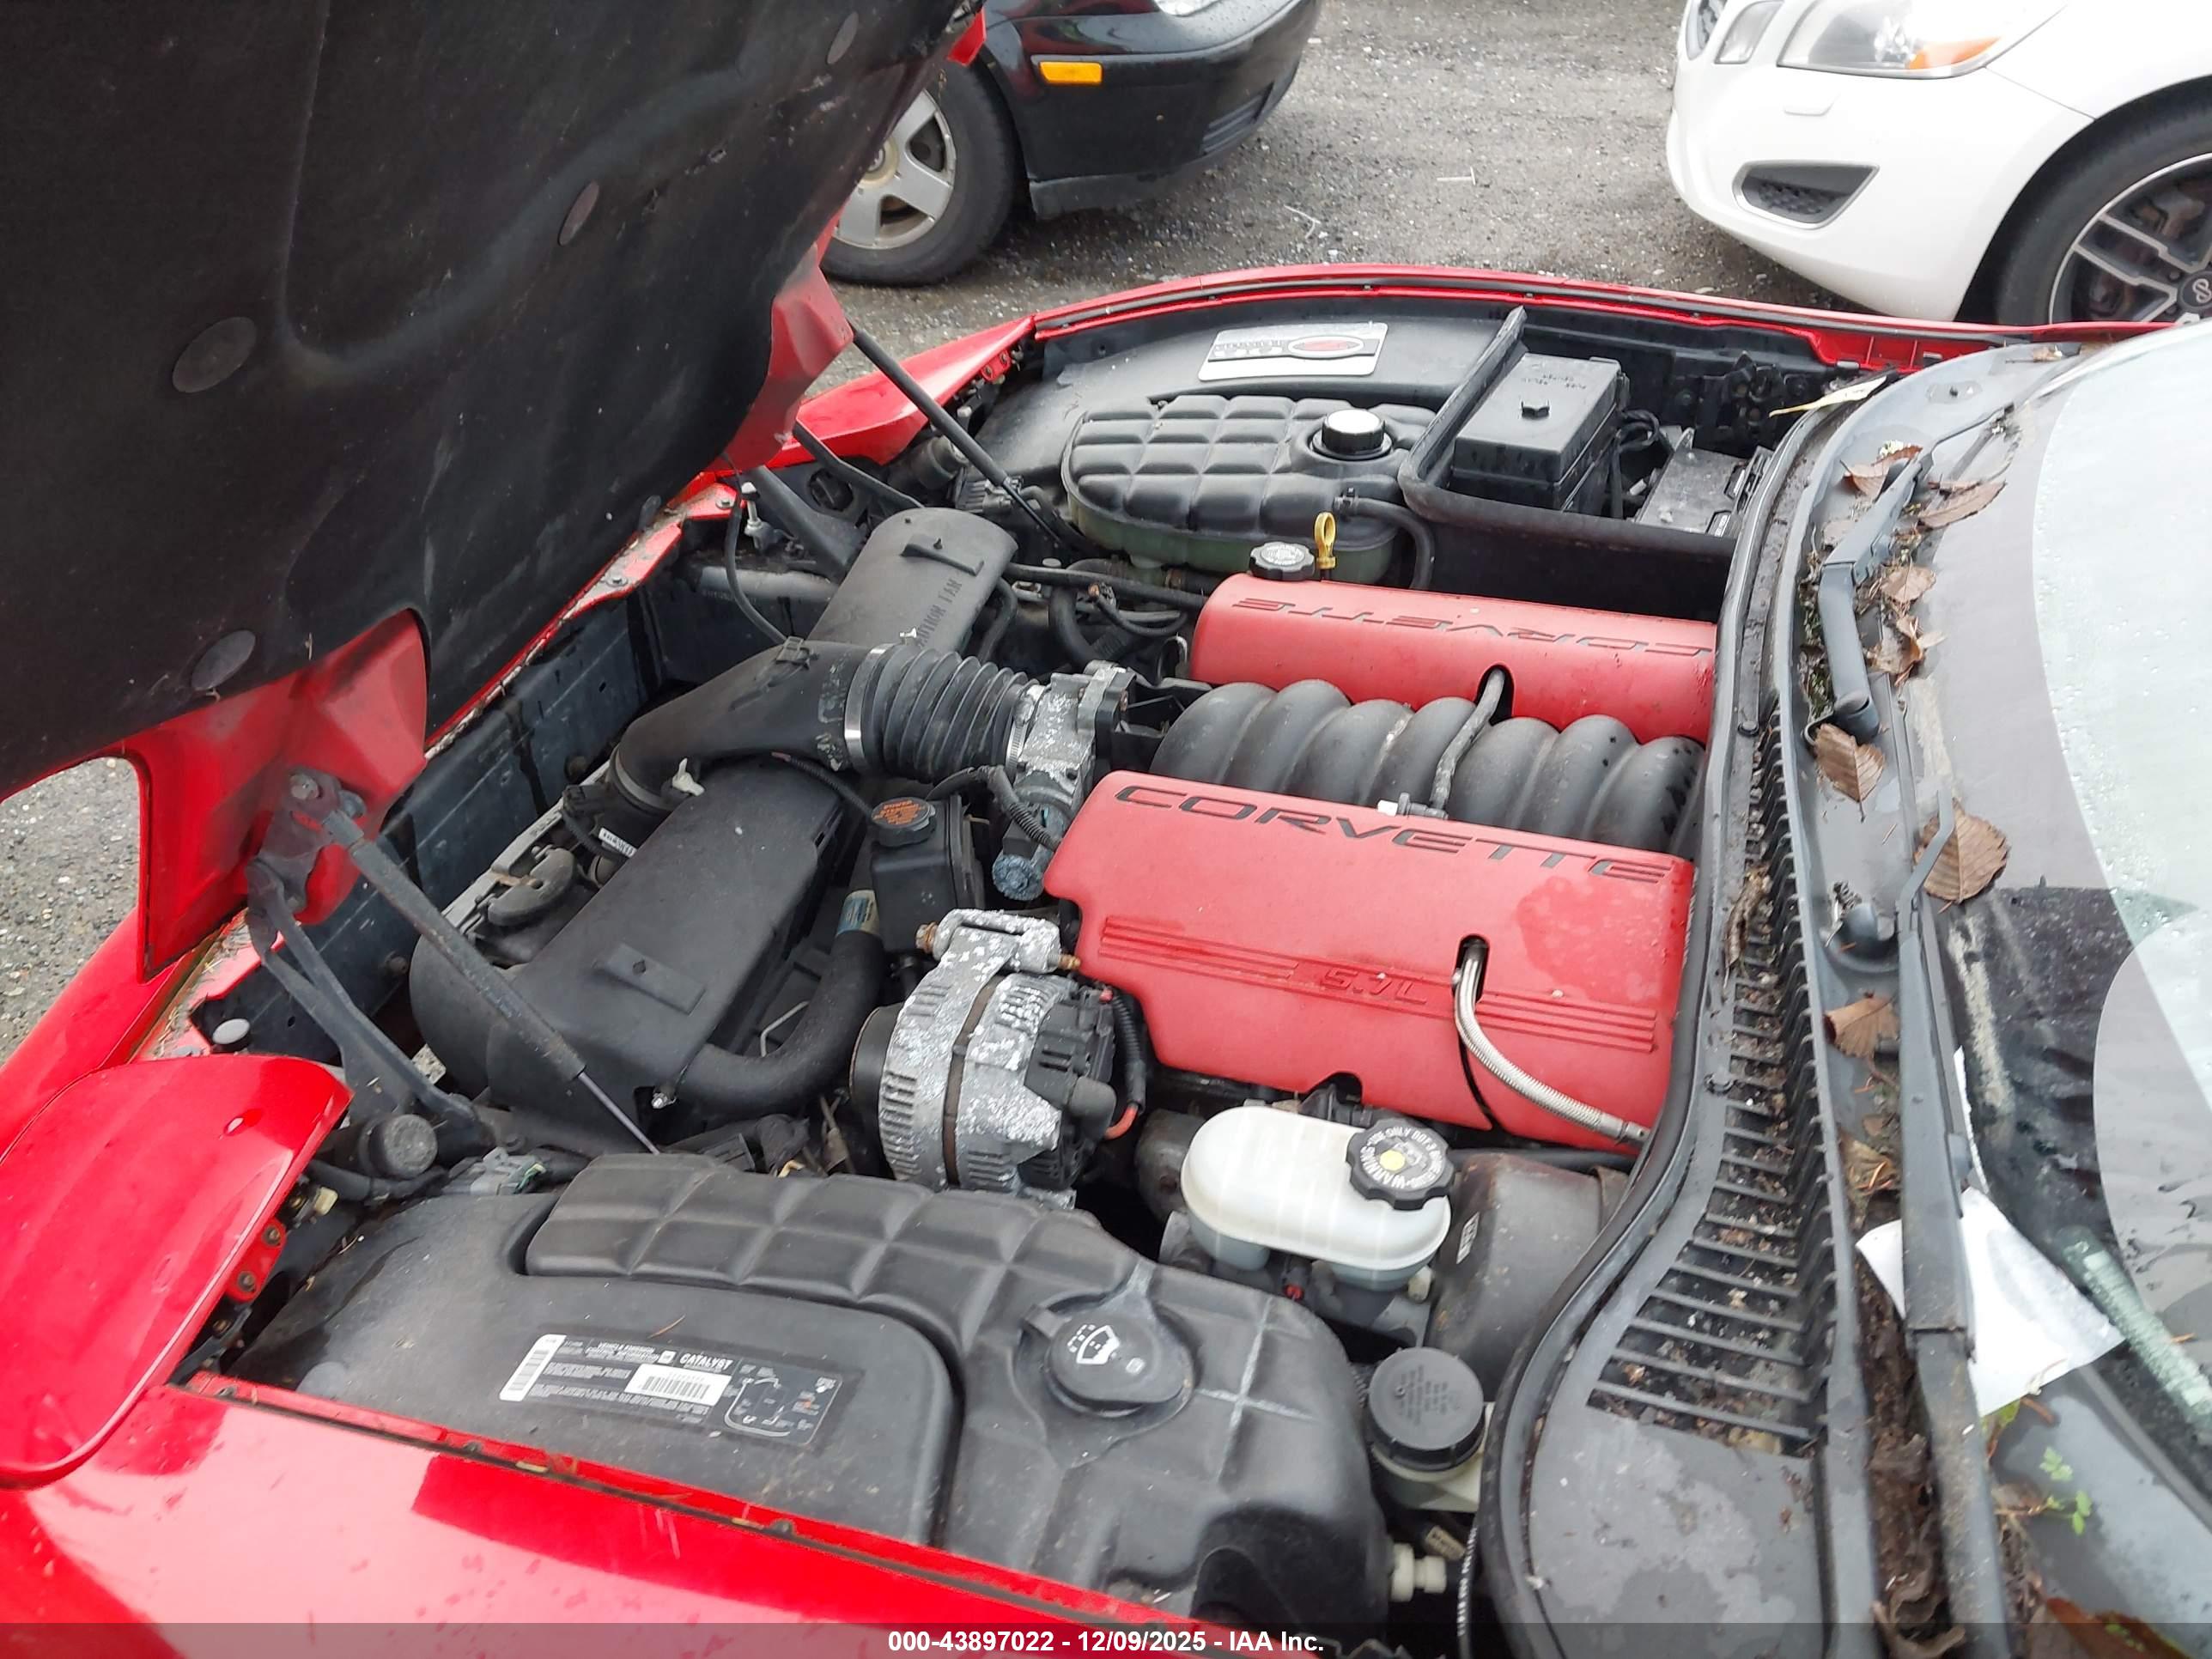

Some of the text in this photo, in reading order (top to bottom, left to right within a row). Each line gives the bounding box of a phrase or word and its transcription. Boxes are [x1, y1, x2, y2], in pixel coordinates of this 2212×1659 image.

[1232, 598, 1714, 656] CORVETTE
[1114, 785, 1672, 884] CORVETTE
[1322, 967, 1427, 1005] 5.7L
[679, 1352, 734, 1370] CATALYST
